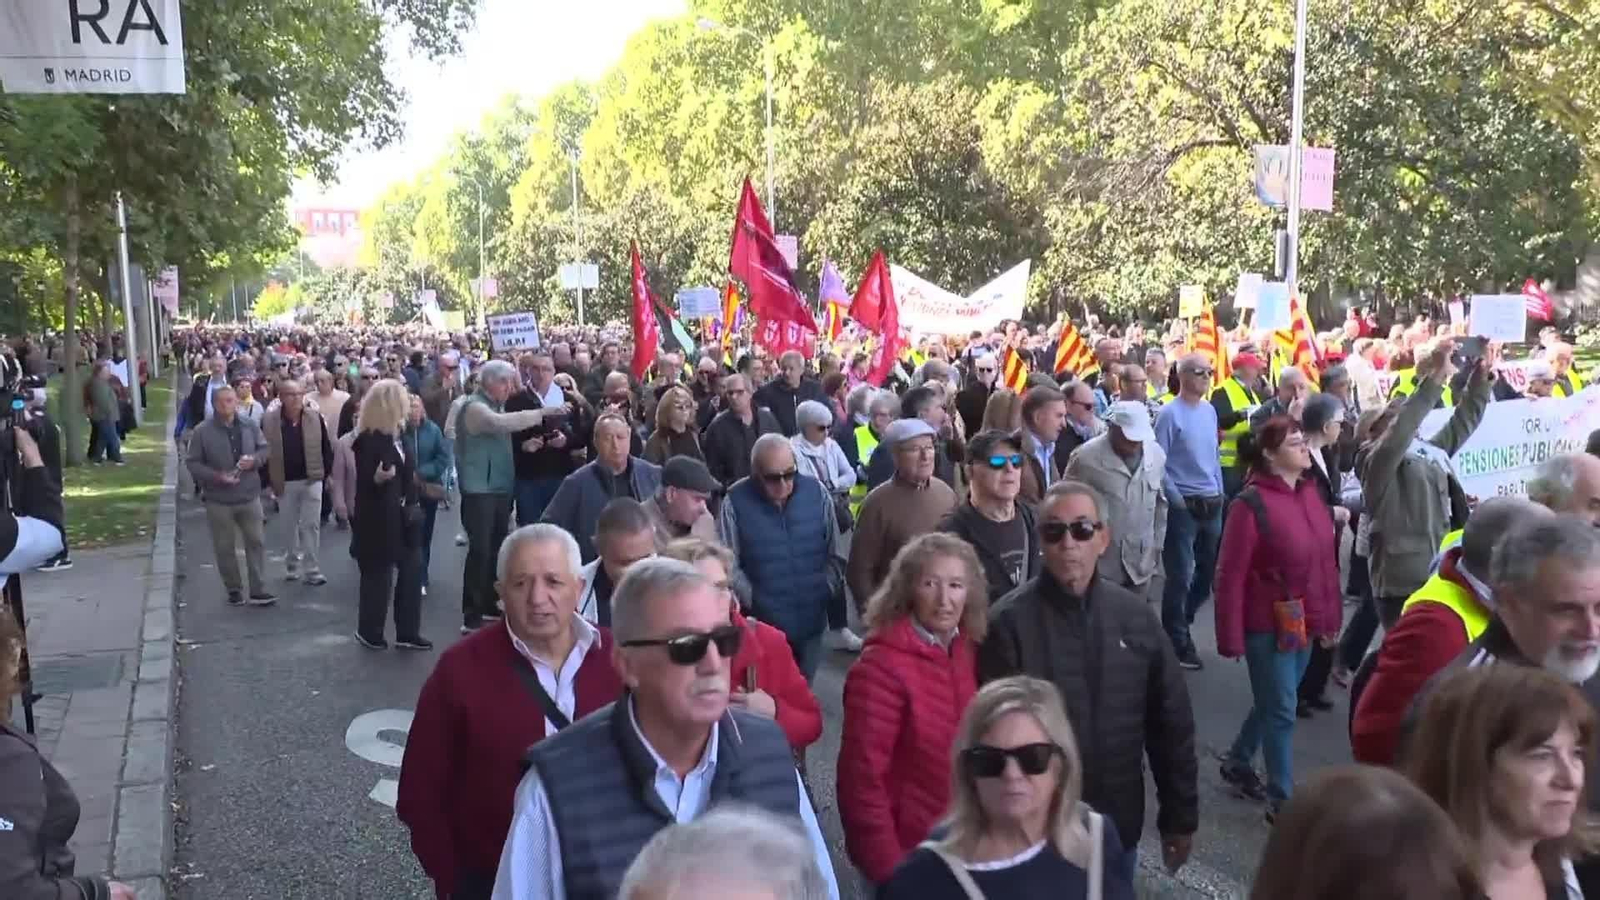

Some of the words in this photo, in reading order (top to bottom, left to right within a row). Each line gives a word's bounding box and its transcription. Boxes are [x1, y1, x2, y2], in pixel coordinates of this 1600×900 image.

[64, 69, 131, 83] MADRID
[515, 325, 535, 333] PAGAR
[1458, 445, 1519, 475] PENSIONES
